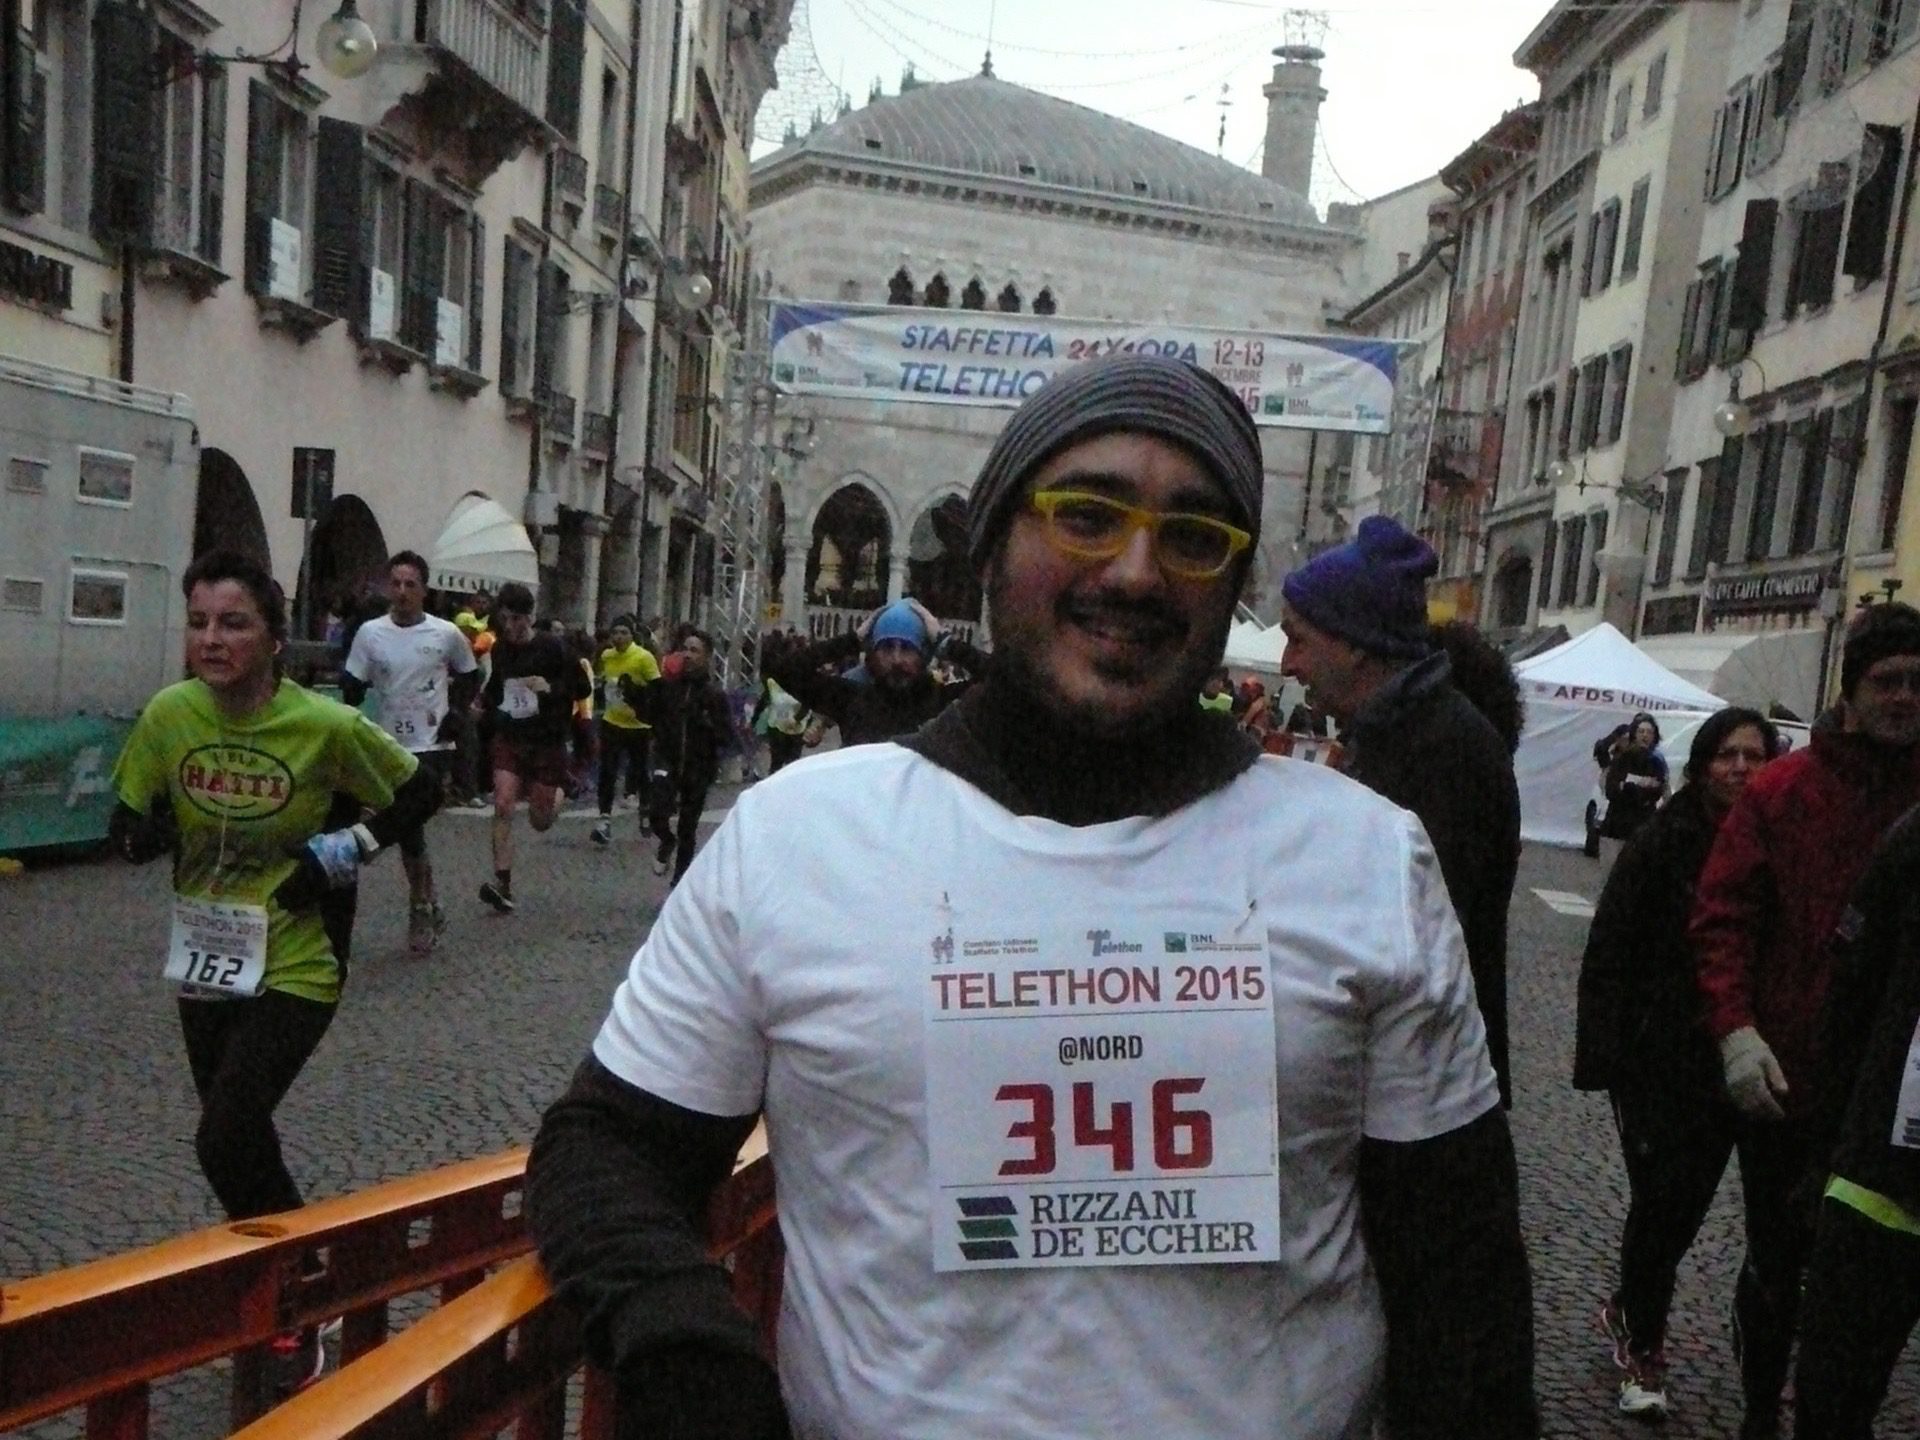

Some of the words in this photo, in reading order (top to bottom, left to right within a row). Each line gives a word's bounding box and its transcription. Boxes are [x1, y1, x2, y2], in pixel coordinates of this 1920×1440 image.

[901, 325, 1054, 358] STAFFETTA
[1213, 339, 1264, 367] 12-13
[900, 361, 1058, 398] TELETHO
[1554, 684, 1615, 703] AFDS
[394, 720, 415, 734] 25
[1086, 929, 1143, 957] Telethon
[185, 951, 244, 987] 162
[931, 966, 1162, 1010] TELETHON
[1175, 965, 1266, 1002] 2015
[1058, 1035, 1144, 1066] @NORD
[994, 1076, 1214, 1177] 346
[1030, 1188, 1197, 1225] RIZZANI
[1031, 1227, 1084, 1259] DE
[1096, 1221, 1258, 1257] ECCHER
